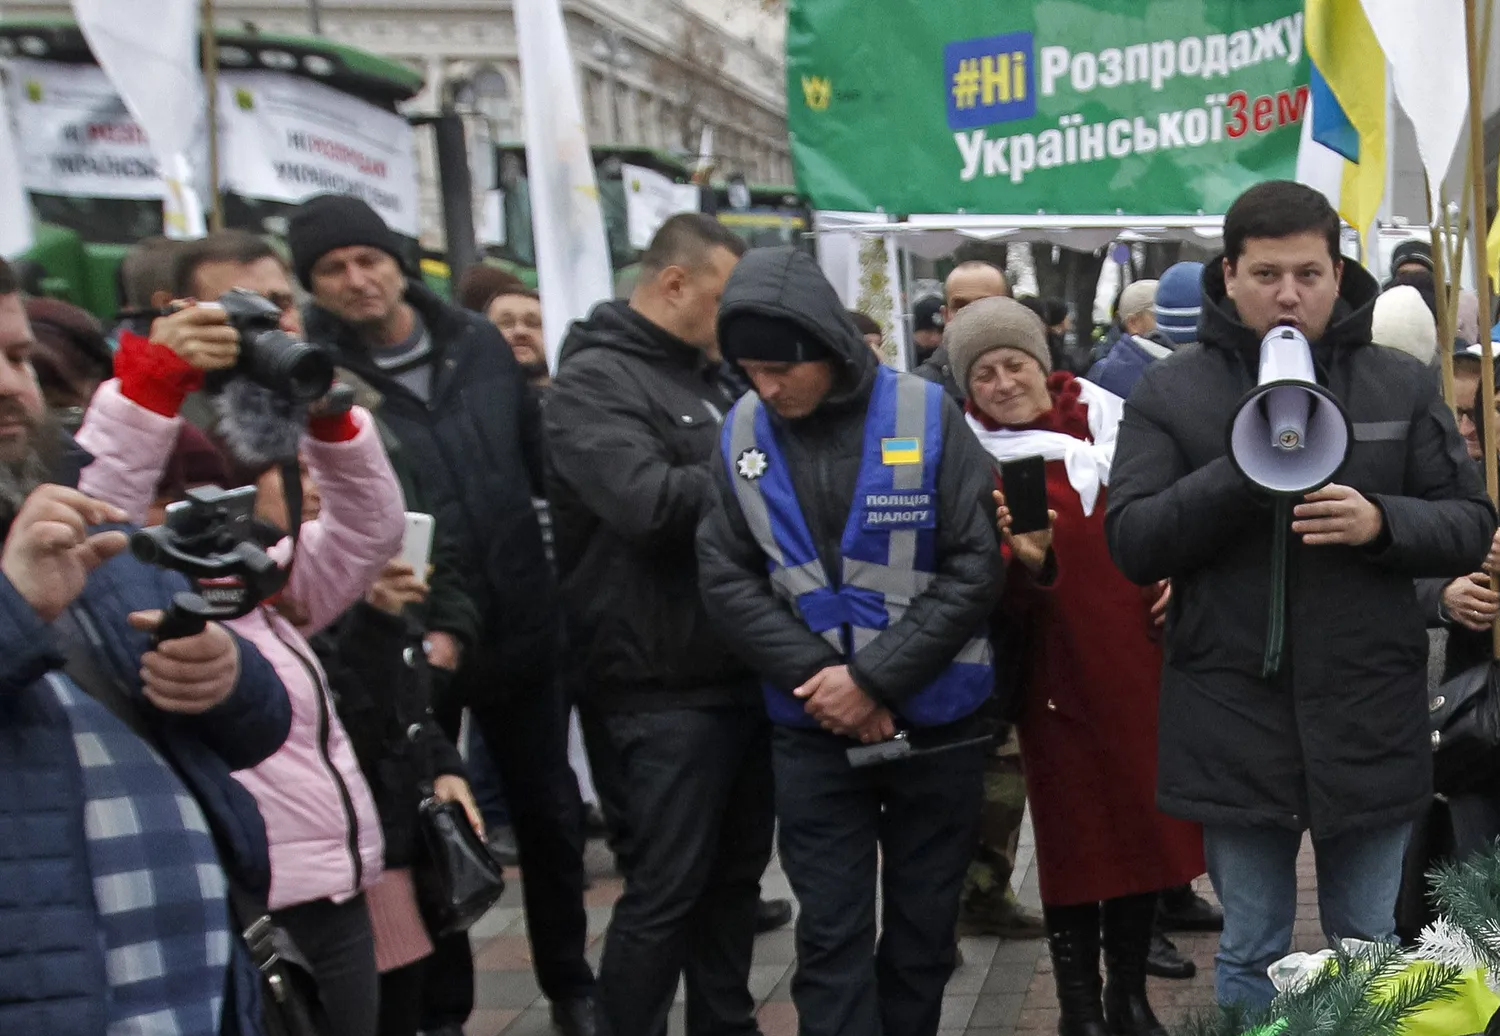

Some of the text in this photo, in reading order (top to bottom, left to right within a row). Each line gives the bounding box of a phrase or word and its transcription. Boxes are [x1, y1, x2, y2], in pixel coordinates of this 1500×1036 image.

[952, 12, 1303, 109] #Ні Розпродажу
[953, 85, 1309, 184] Української Зем
[867, 494, 929, 506] ПОЛІЦІЯ
[867, 511, 928, 524] ДІАЛОГУ
